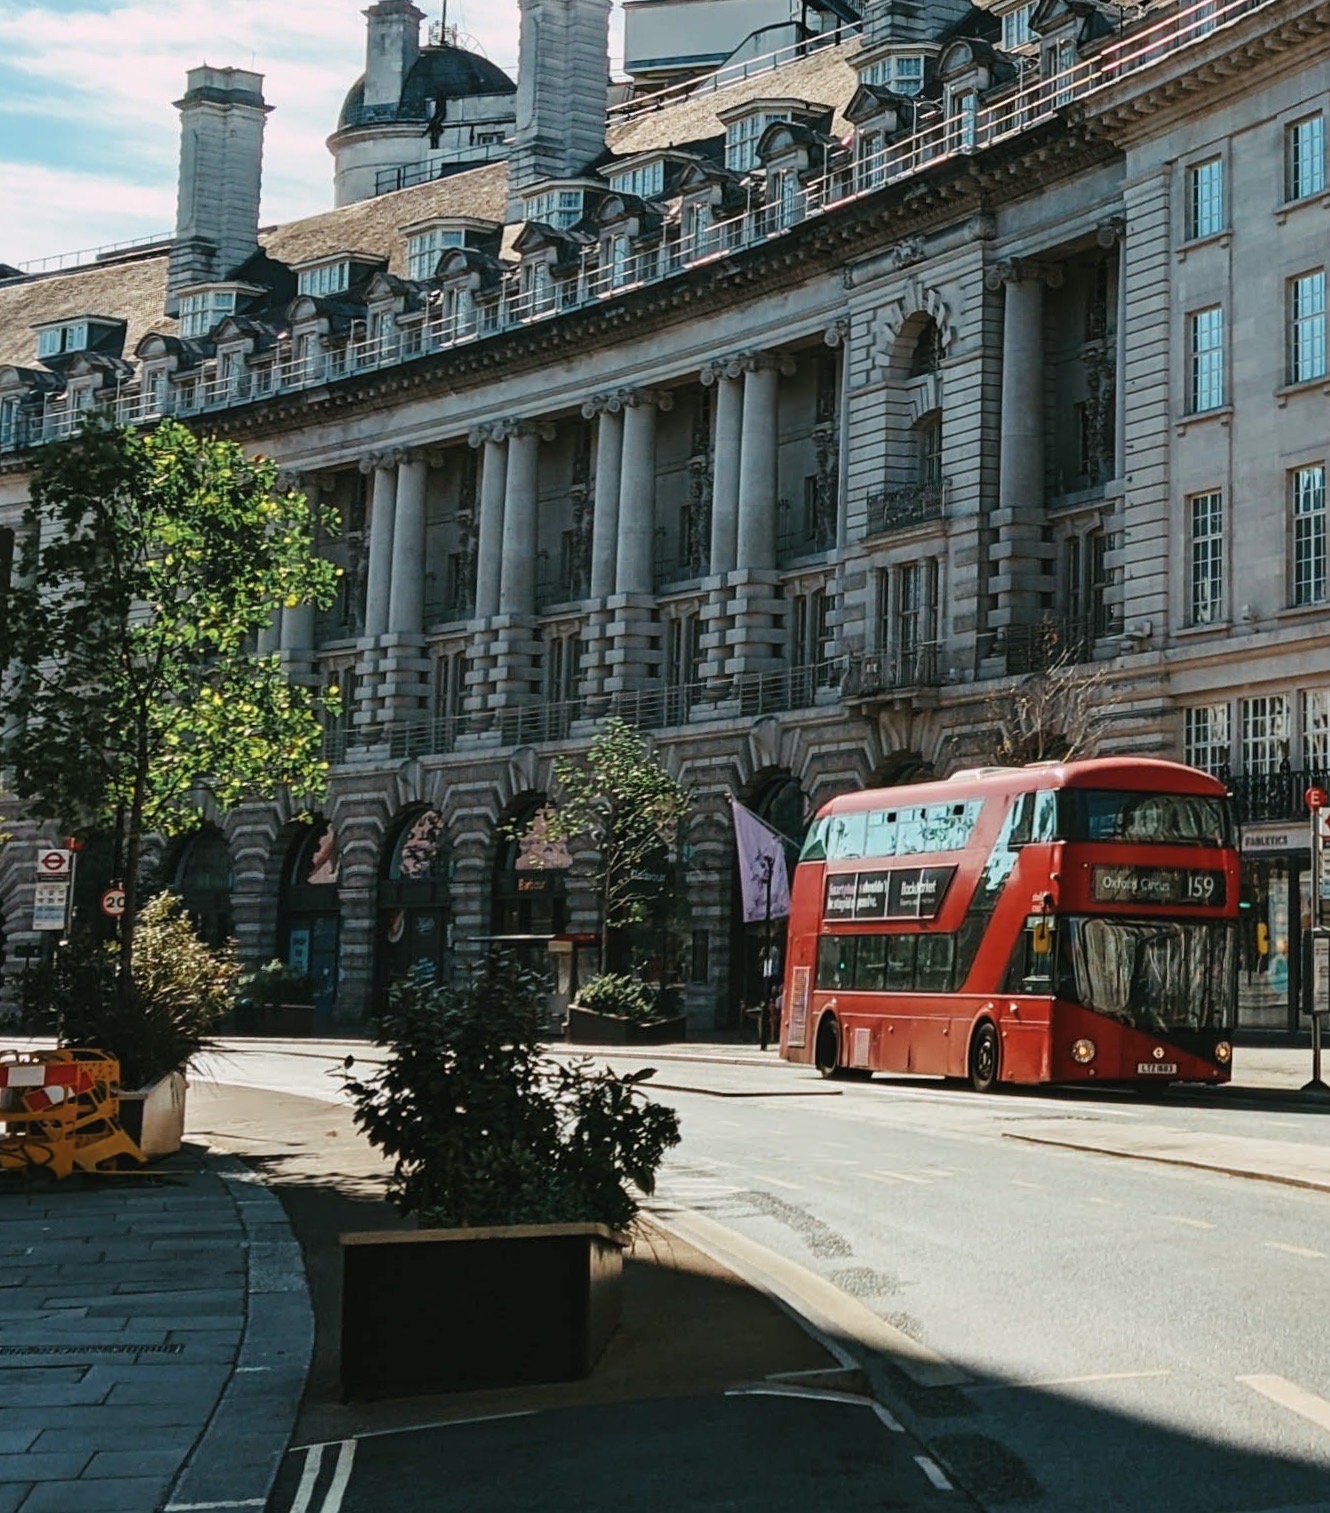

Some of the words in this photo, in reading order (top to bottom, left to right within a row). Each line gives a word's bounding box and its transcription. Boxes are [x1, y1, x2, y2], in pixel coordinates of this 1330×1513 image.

[1311, 790, 1320, 805] E
[1102, 876, 1138, 891] Oxford
[1140, 878, 1170, 892] Circus
[1187, 875, 1215, 898] 159
[106, 896, 126, 908] 20
